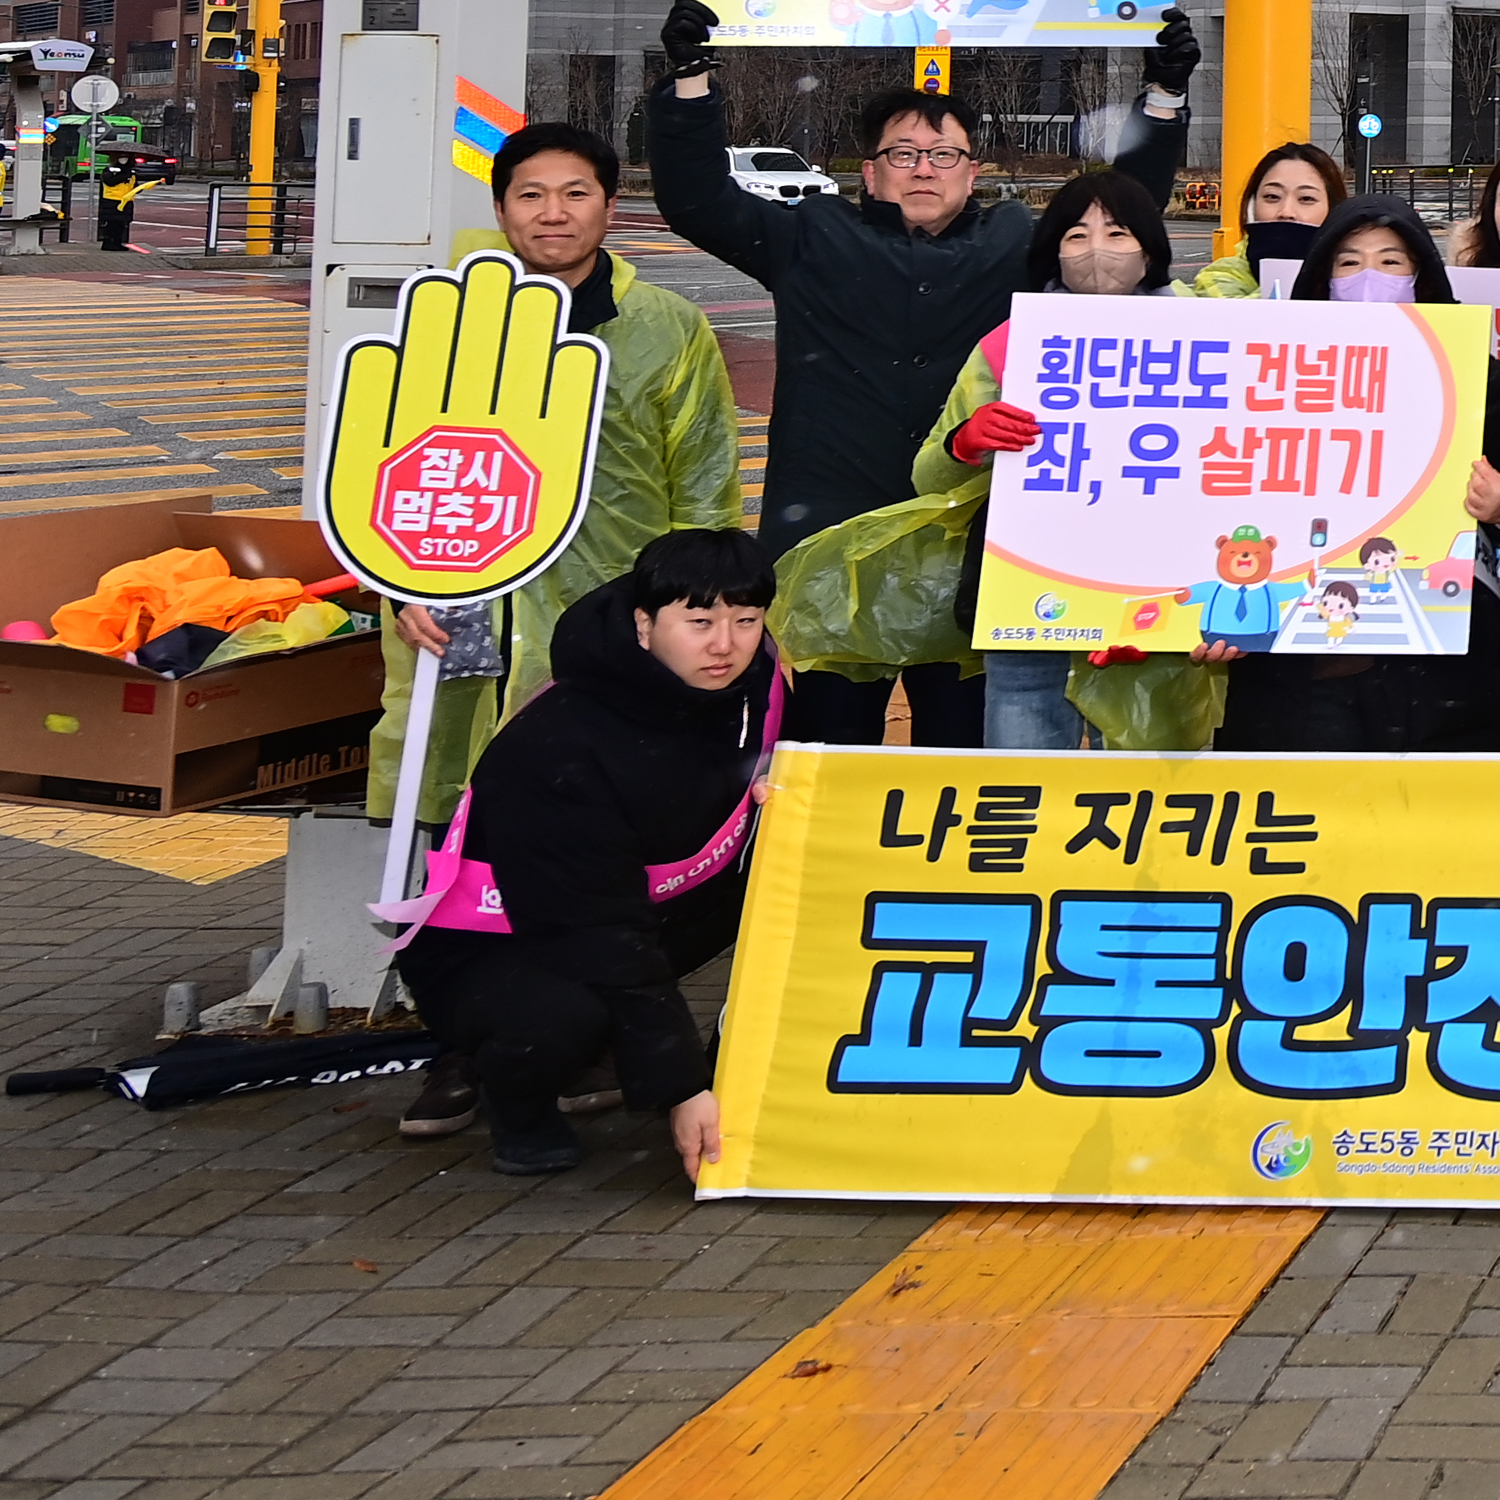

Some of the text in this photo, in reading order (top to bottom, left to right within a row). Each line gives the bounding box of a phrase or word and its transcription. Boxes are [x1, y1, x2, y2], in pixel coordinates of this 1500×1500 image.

[39, 49, 85, 59] Yeonsu
[1036, 335, 1389, 413] 횡단보도 건널때
[419, 448, 503, 490] 잠시
[1023, 422, 1384, 506] 좌, 우 살피기
[392, 491, 518, 536] 멈추기
[419, 539, 480, 558] STOP
[1136, 611, 1157, 622] STOP
[991, 627, 1103, 642] 송도5동 주민자치회
[257, 753, 331, 789] Middle
[880, 786, 1041, 871] 나를
[1068, 791, 1318, 875] 지키는
[1333, 1128, 1419, 1158] 송도5동
[1336, 1162, 1416, 1176] Songdo-5dong
